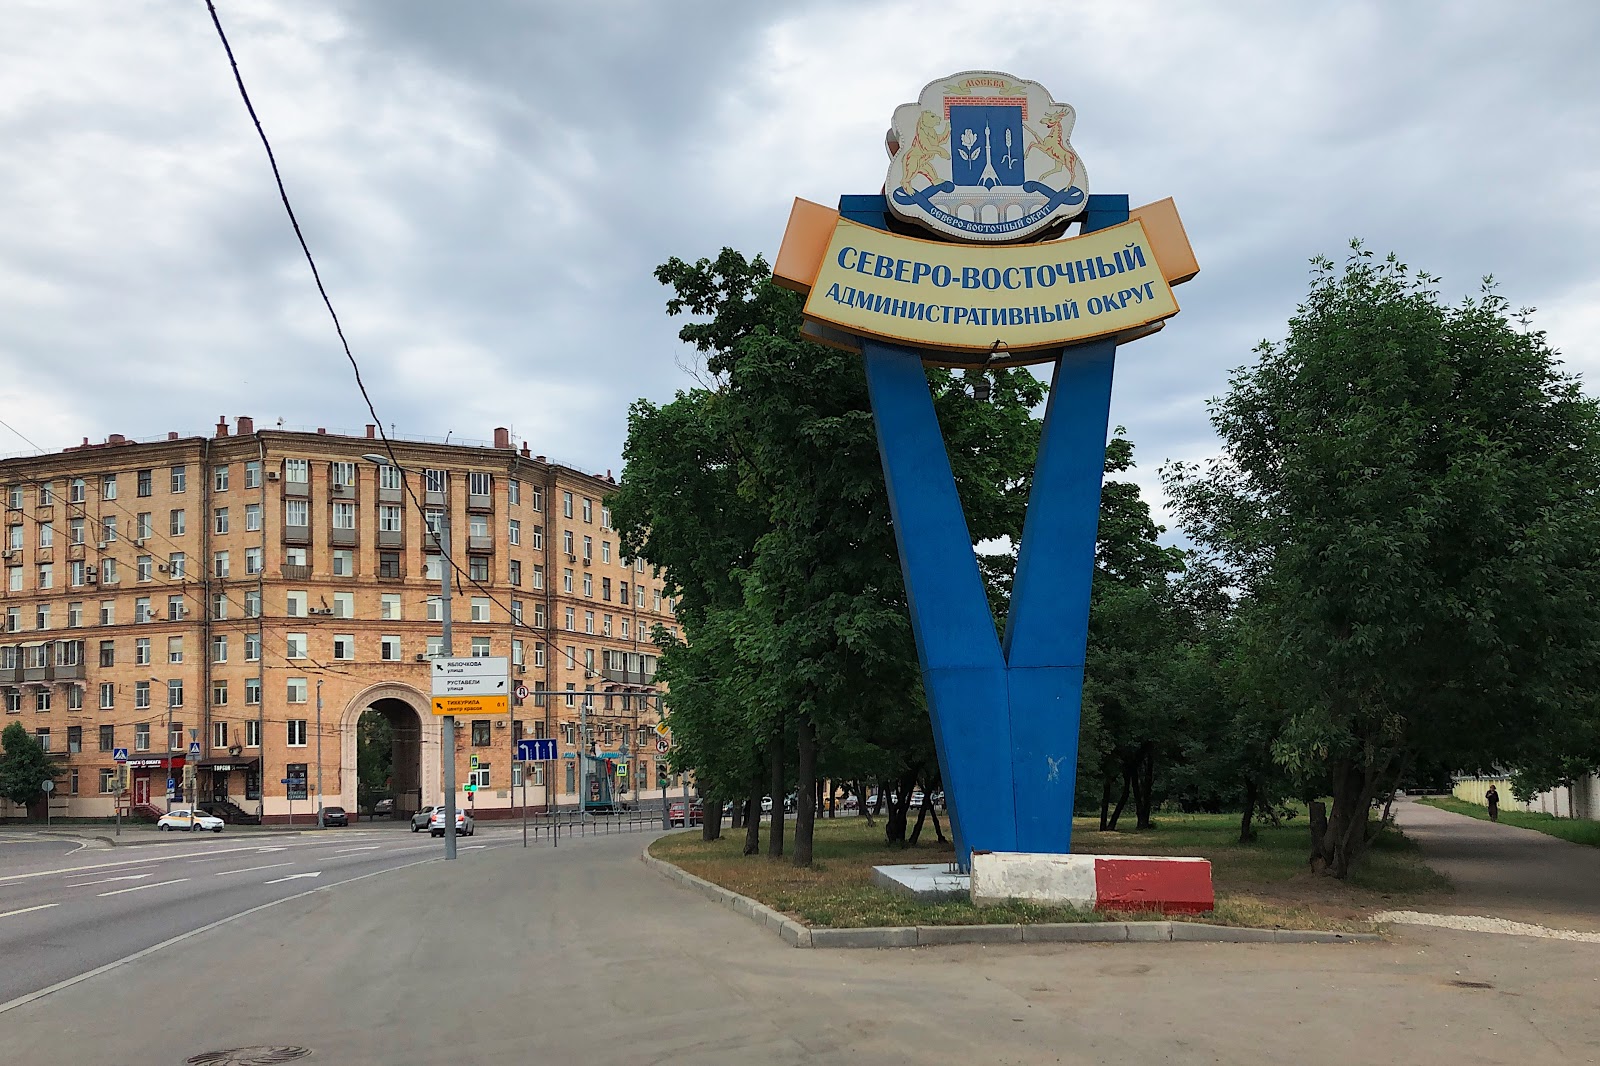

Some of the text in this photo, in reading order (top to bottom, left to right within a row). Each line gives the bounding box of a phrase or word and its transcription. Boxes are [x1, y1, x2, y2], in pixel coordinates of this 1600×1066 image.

[965, 79, 1005, 88] МОСКВА
[930, 206, 1051, 233] СЕВЕРО-ВОСТОЧНЫЙ ОКРУГ
[837, 243, 1146, 290] СЕВЕРО-ВОСТОЧНЫЙ
[825, 281, 1155, 326] АДМИНИСТРАТИВНЫЙ ОКРУГ
